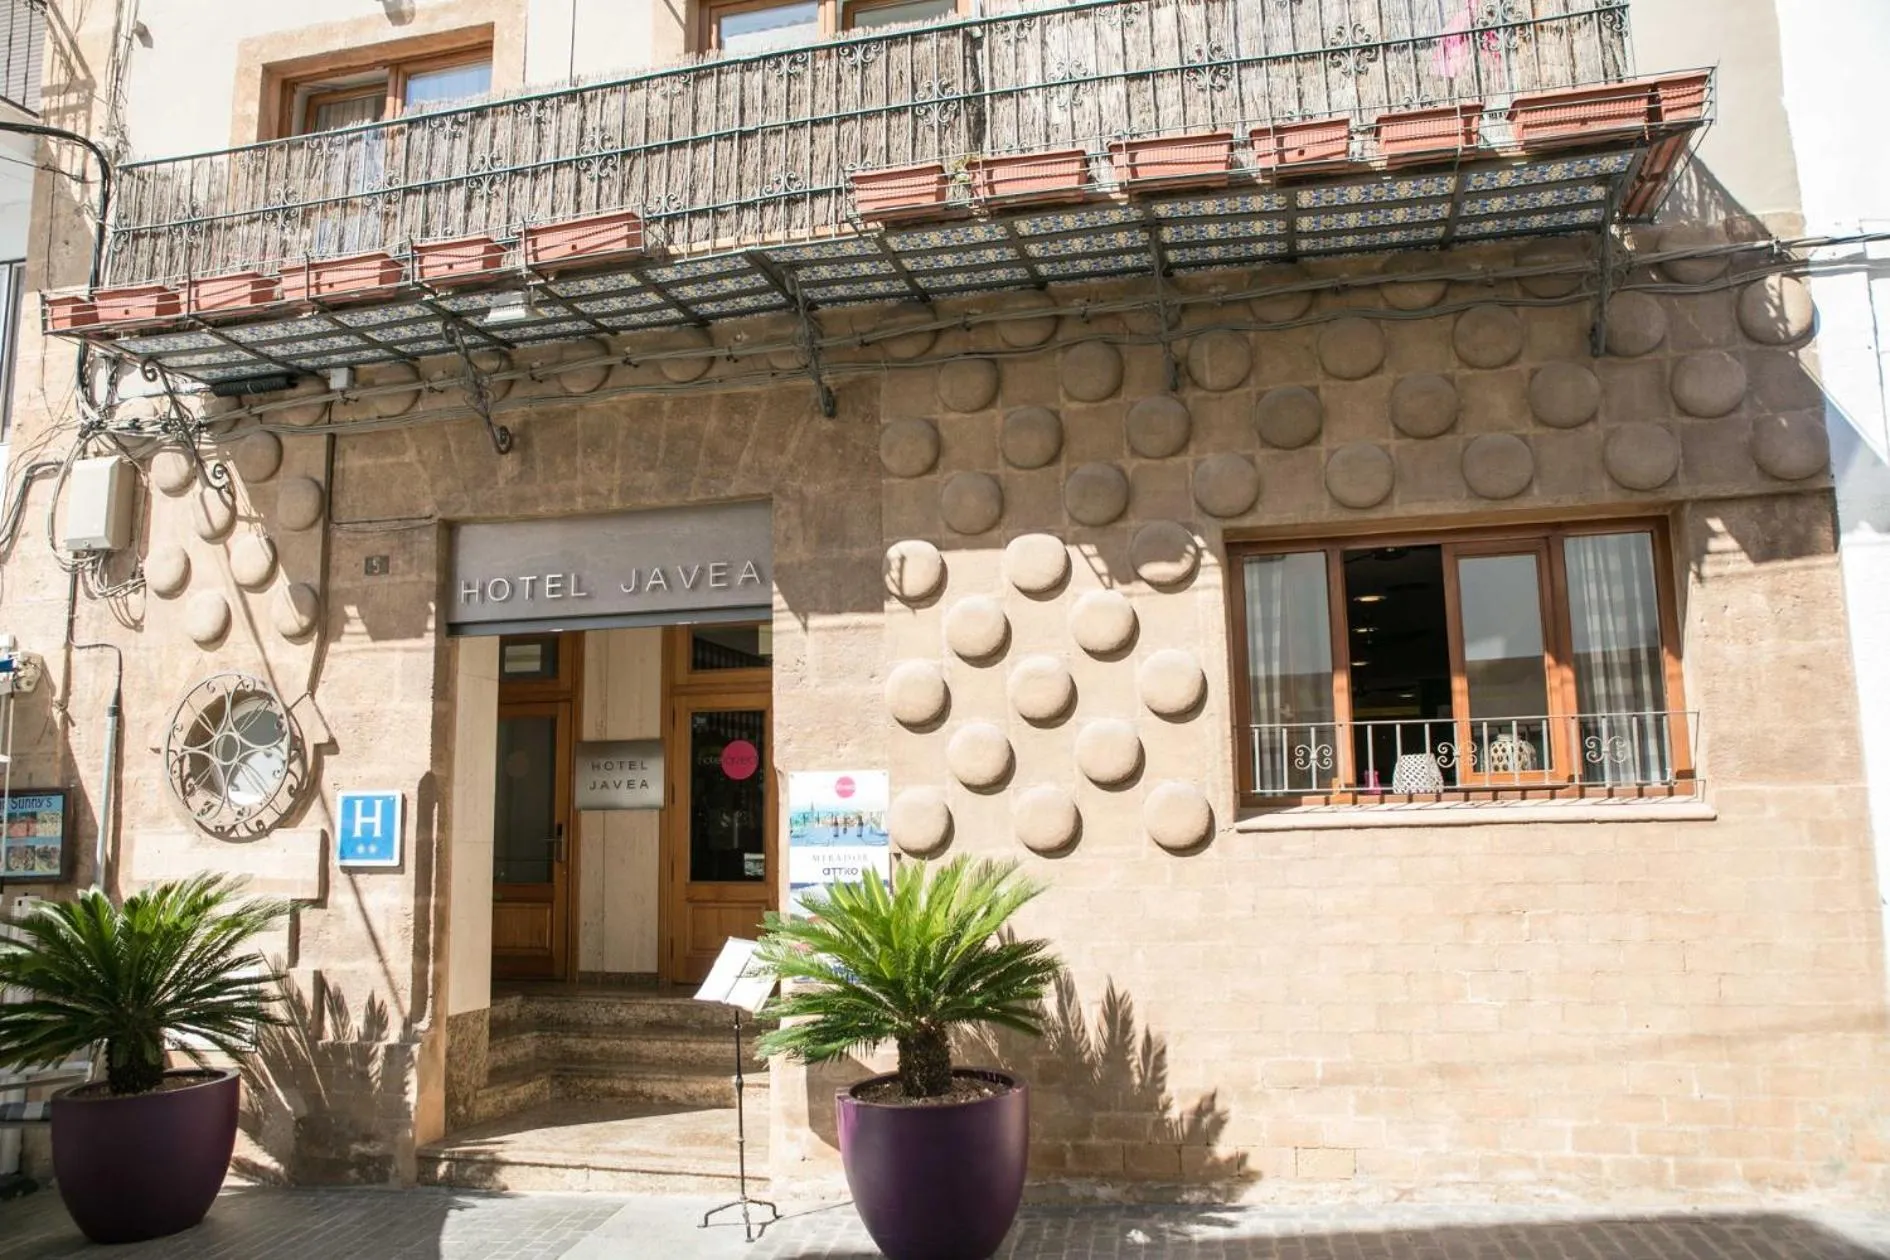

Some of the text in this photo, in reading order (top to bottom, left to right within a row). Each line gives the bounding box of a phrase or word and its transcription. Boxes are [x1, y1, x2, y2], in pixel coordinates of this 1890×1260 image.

[461, 560, 761, 603] HOTEL JAVEA
[591, 760, 649, 772] HOTEL
[588, 779, 649, 791] JAVEA
[352, 799, 383, 837] H
